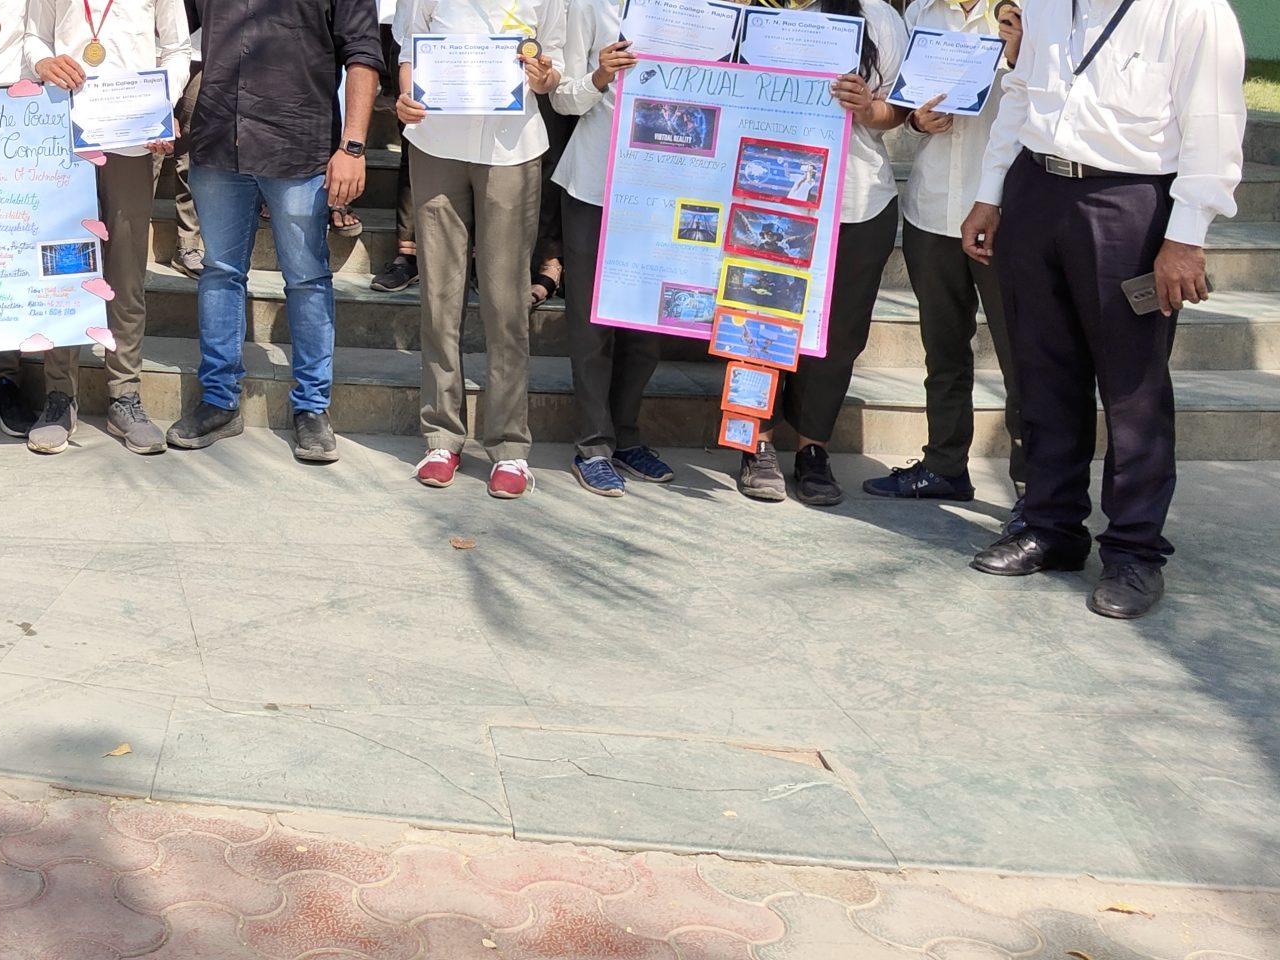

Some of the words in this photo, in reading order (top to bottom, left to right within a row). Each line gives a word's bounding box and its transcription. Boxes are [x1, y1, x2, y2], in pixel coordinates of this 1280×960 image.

[663, 1, 678, 9] Rao
[678, 3, 706, 15] College
[710, 10, 734, 21] Rajkot
[798, 22, 825, 30] College
[831, 25, 855, 34] Rajkot
[463, 44, 490, 52] College
[495, 43, 518, 52] Rajkot
[657, 63, 746, 99] VIRTUAL
[754, 71, 835, 109] REALITY
[23, 100, 70, 129] Power
[737, 117, 799, 136] APPLICATIONS
[803, 127, 815, 138] OF
[820, 128, 837, 141] VR
[0, 131, 74, 170] Computing
[614, 193, 640, 206] TYPES
[645, 197, 657, 208] OF
